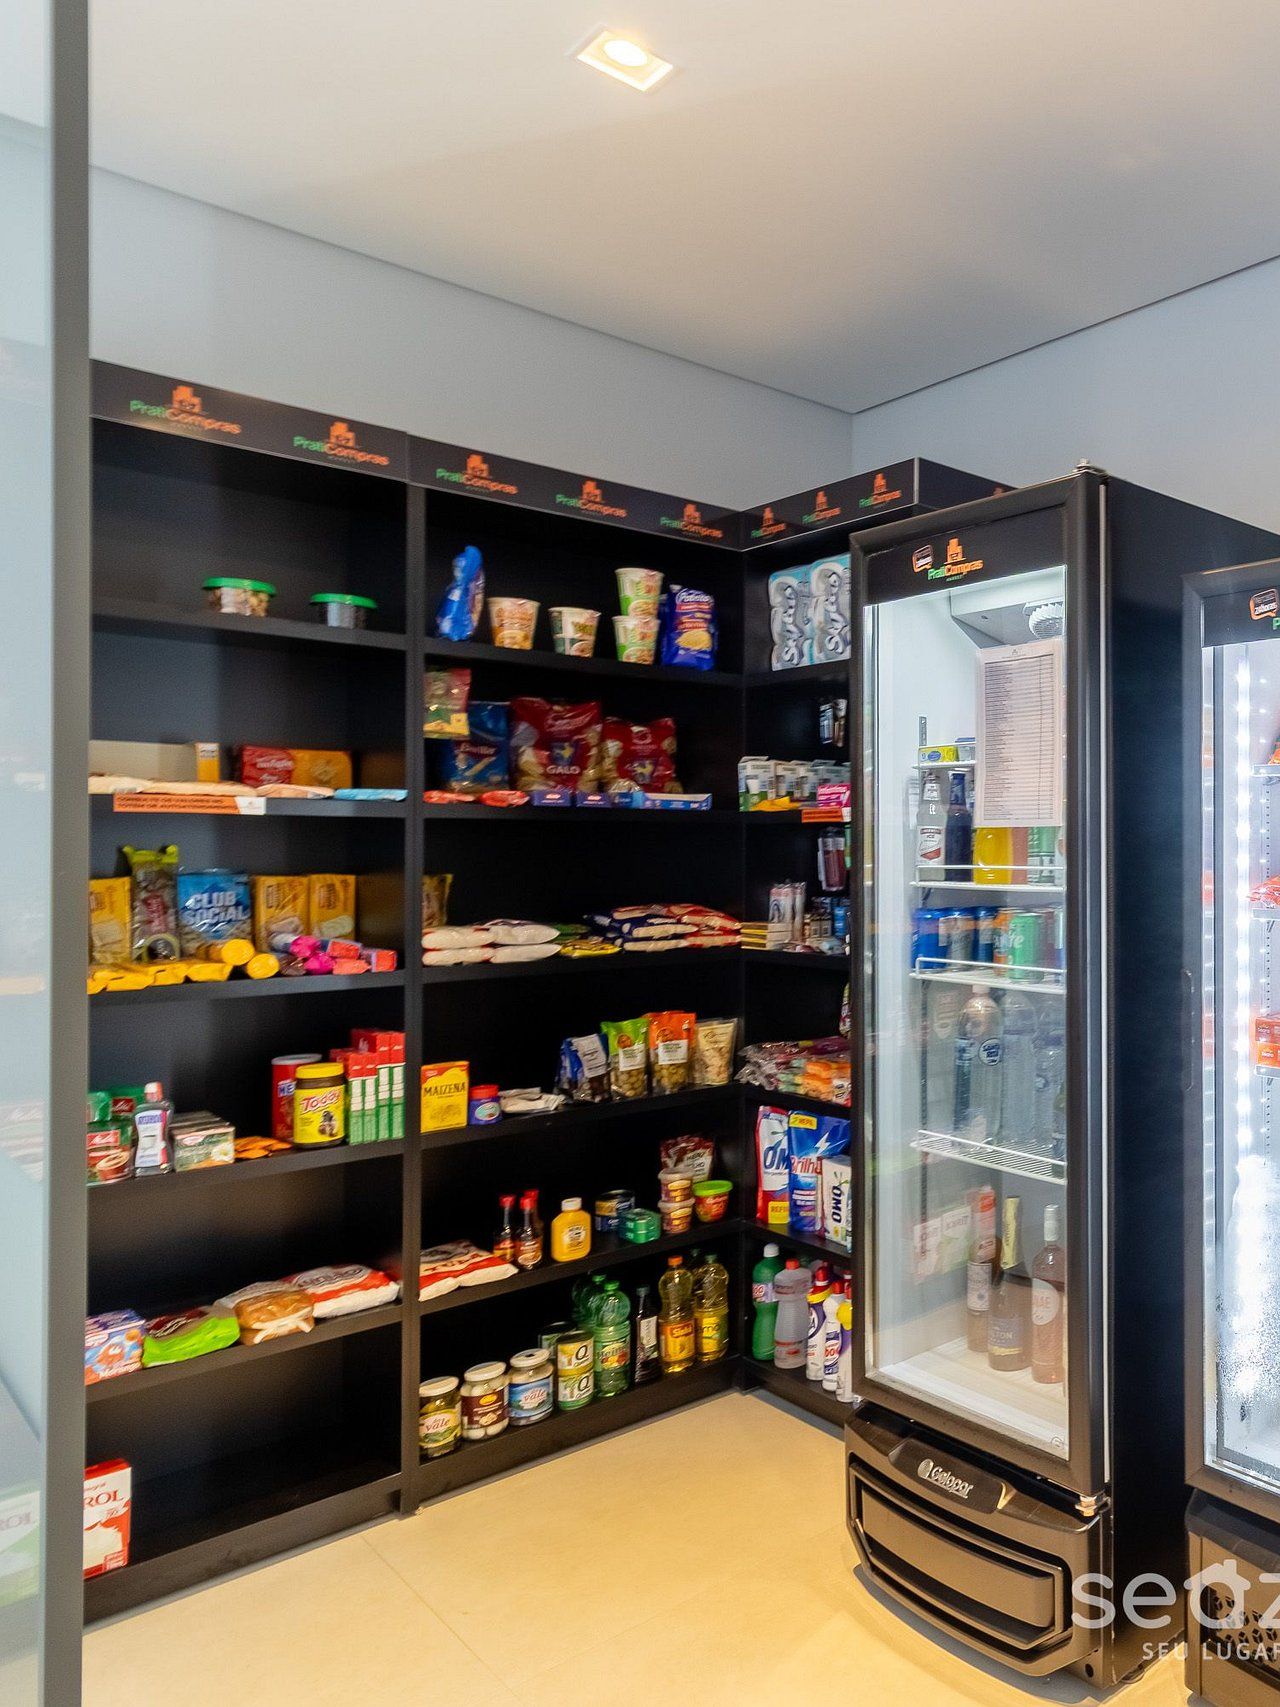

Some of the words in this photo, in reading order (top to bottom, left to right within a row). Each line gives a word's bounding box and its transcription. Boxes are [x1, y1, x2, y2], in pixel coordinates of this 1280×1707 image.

[129, 399, 242, 435] PratiCompras
[293, 435, 390, 466] PratiCompras
[435, 468, 518, 495] PratiCompras
[555, 494, 628, 518] PratiCompras
[546, 765, 580, 775] GALO
[189, 890, 237, 907] CLUB
[424, 1082, 466, 1097] MAIZENA
[831, 1185, 842, 1224] OMO
